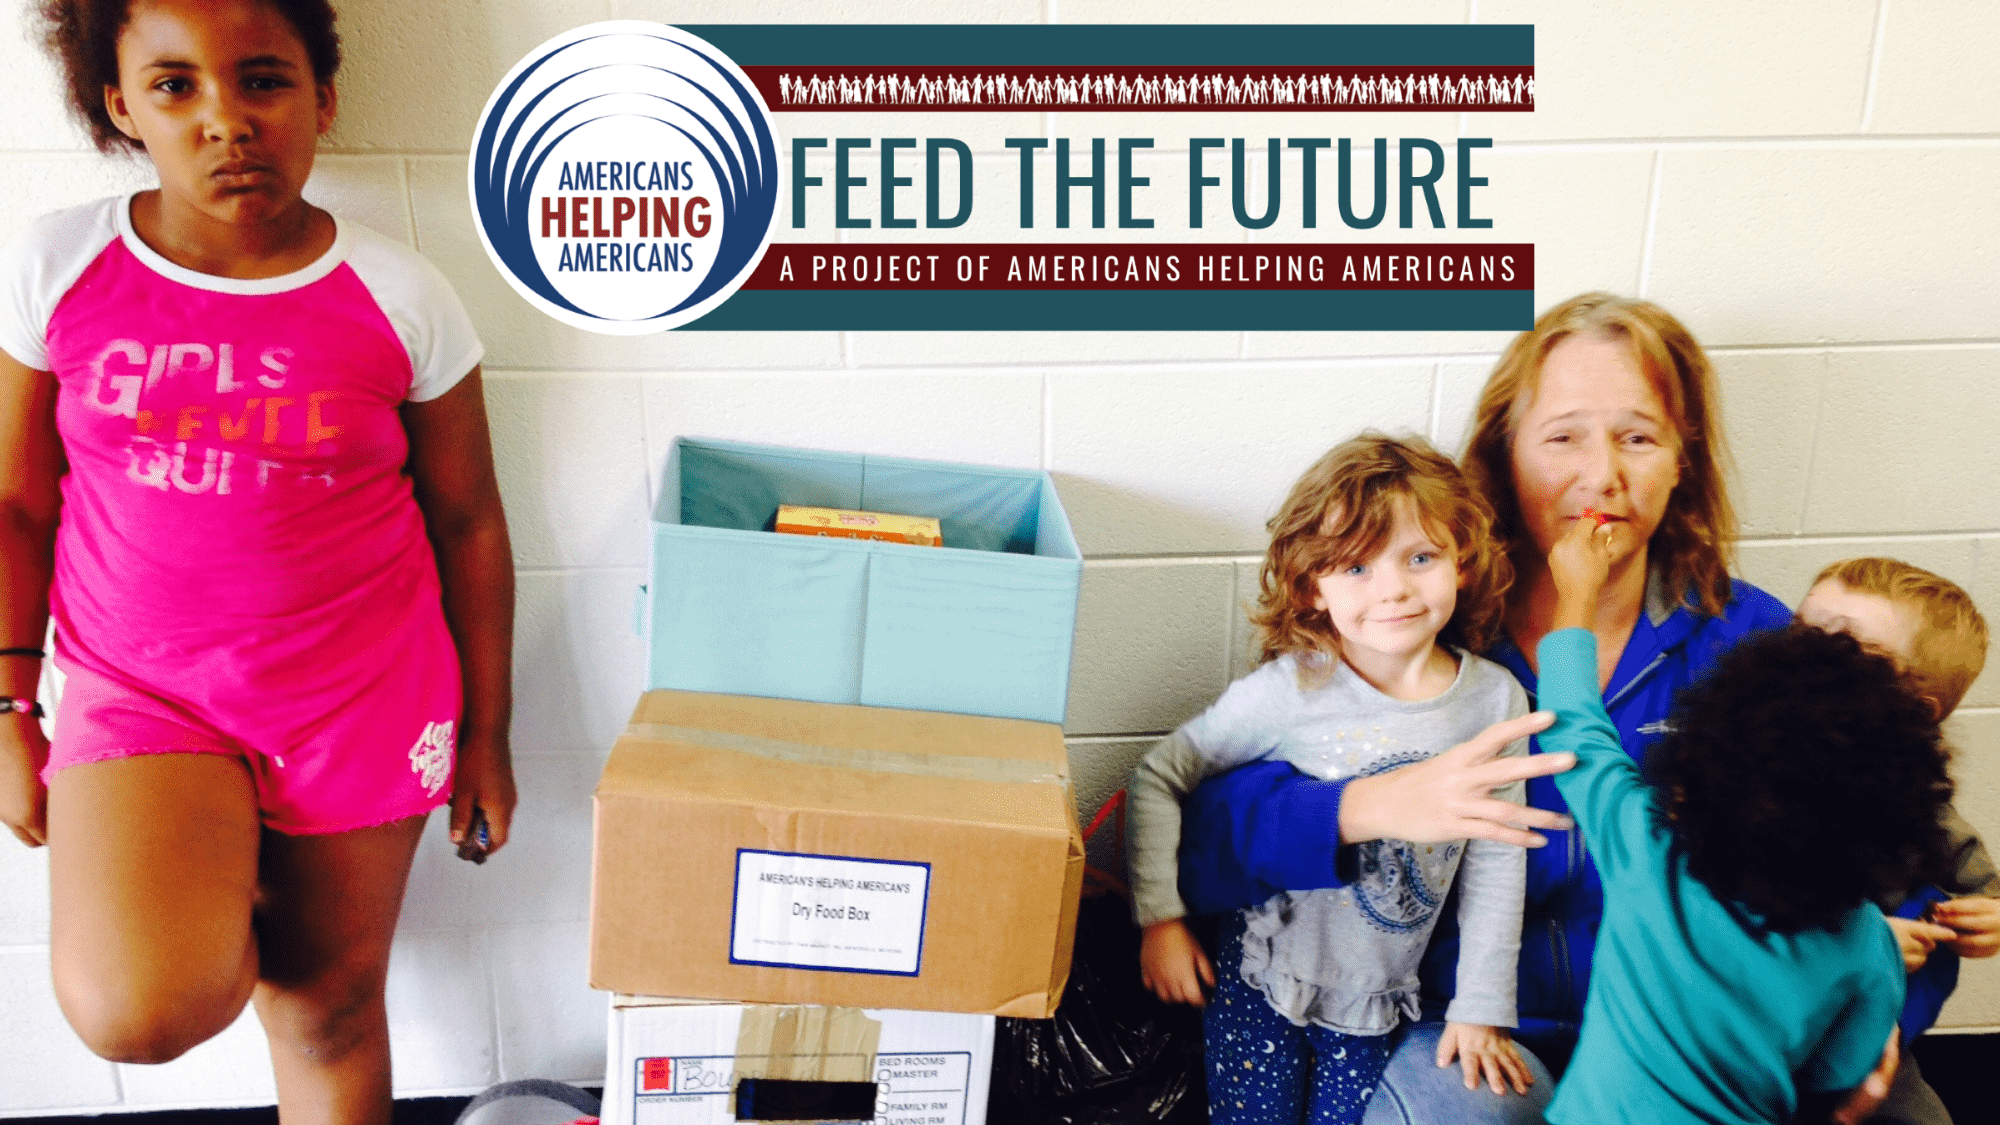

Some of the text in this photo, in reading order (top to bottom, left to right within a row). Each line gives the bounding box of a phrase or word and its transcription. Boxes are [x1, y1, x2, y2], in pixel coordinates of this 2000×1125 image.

[816, 876, 854, 890] HELPING
[792, 902, 871, 921] Dry Food Box
[879, 1056, 946, 1067] BED ROOMS
[892, 1070, 938, 1079] MASTER
